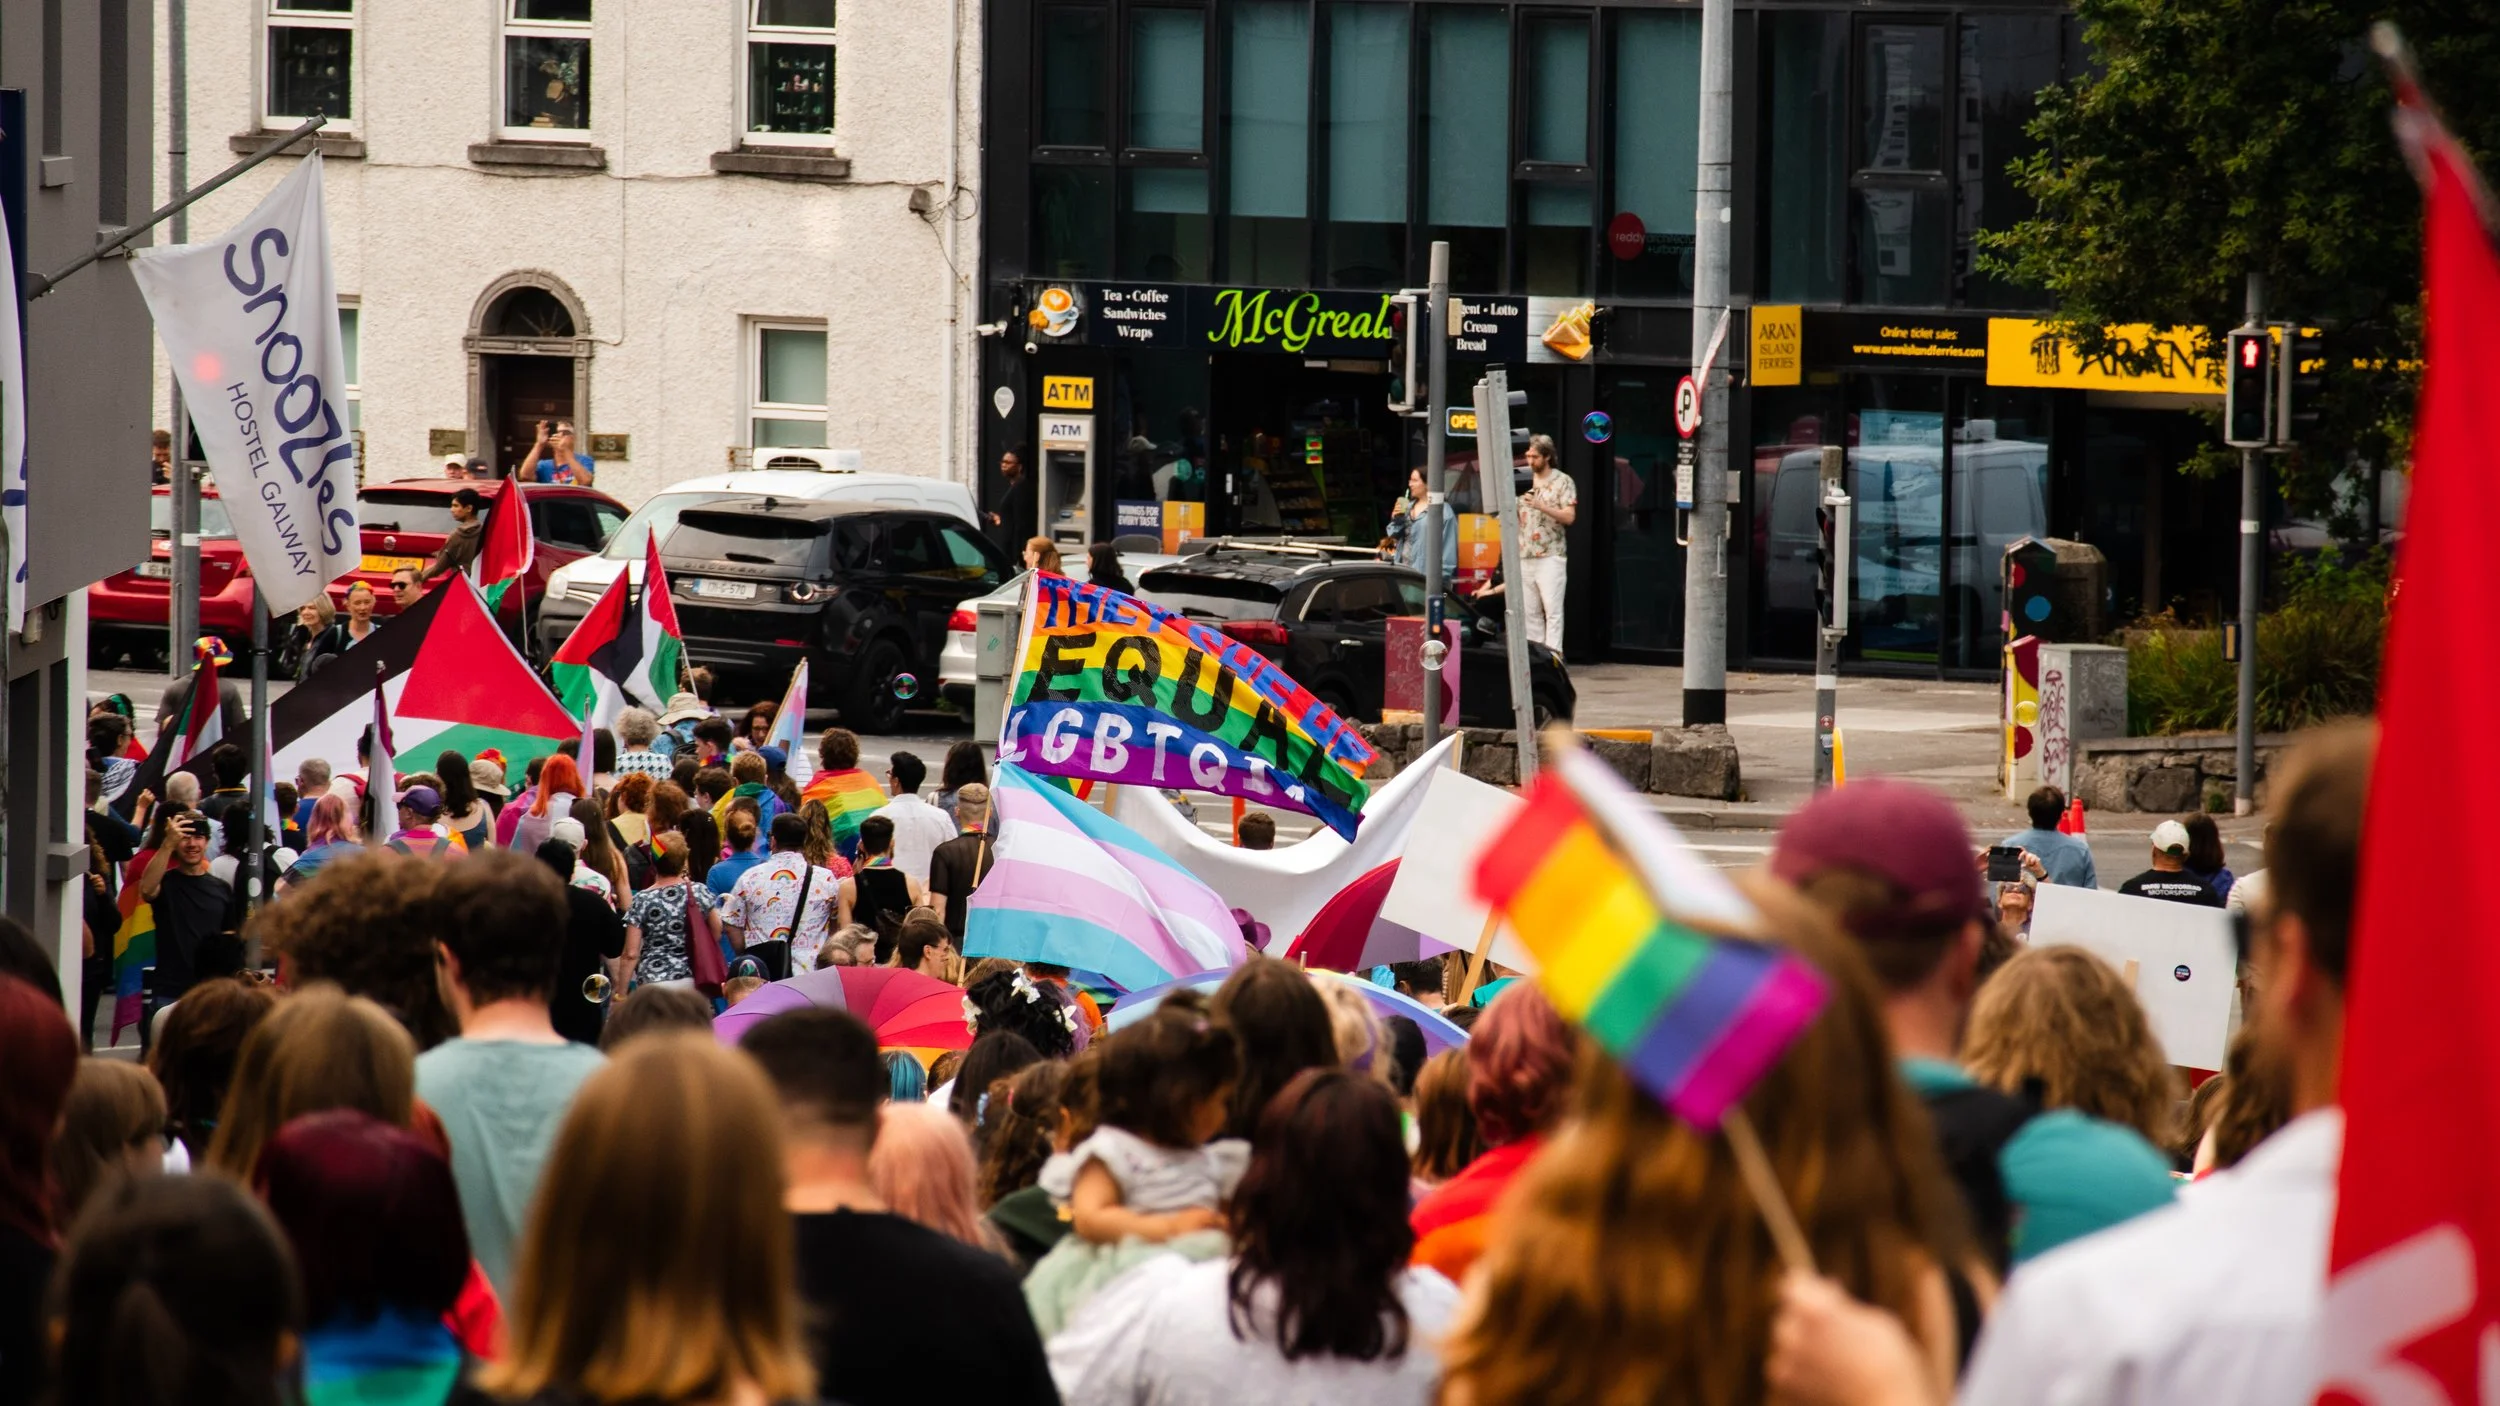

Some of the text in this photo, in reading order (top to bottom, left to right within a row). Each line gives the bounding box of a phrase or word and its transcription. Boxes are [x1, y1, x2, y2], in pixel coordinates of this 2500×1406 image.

[1615, 232, 1645, 245] reddy
[1102, 289, 1169, 303] Tea Coffee
[1103, 306, 1167, 320] Sandwiches
[1490, 303, 1518, 316] Lotto
[1117, 325, 1153, 341] Wraps
[1463, 320, 1498, 334] Cream
[1758, 322, 1796, 340] ARAN
[1880, 326, 1909, 339] Online
[1910, 327, 1934, 339] ticket
[1456, 338, 1487, 351] Bread
[1759, 343, 1795, 355] ISLAND
[1852, 343, 1985, 358] www.aranislandferries.com
[1758, 357, 1795, 370] FERRIES
[1047, 383, 1090, 402] ATM
[1450, 414, 1478, 430] OPE
[1050, 424, 1081, 436] ATM
[599, 436, 617, 451] 35
[226, 381, 317, 578] HOSTEL GALWAY
[1146, 506, 1160, 518] FOR
[1118, 515, 1139, 526] EVERY
[1039, 577, 1185, 633] THEY
